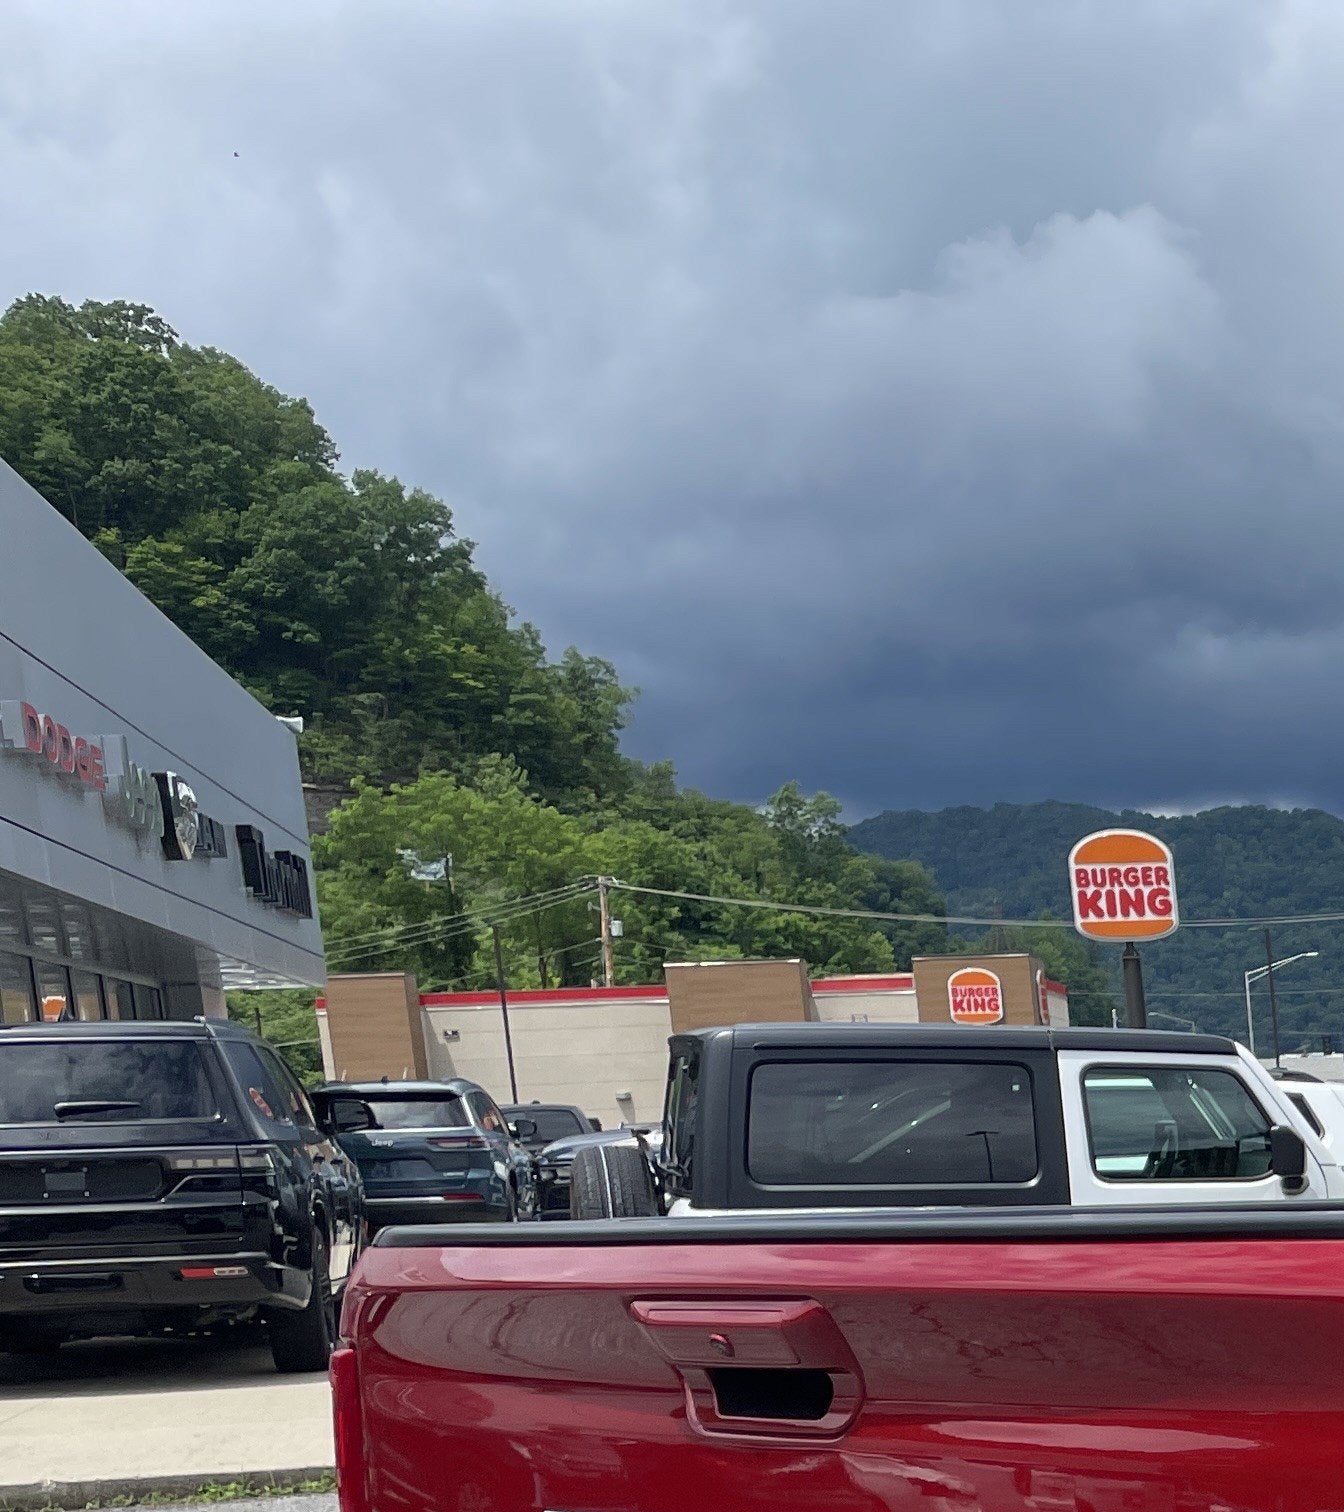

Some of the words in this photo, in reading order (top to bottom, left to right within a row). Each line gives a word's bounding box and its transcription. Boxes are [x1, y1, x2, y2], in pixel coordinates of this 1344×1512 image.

[20, 701, 106, 792] DODGE
[1075, 866, 1170, 888] BURGER
[1077, 887, 1173, 919] KING
[951, 987, 999, 998] BURGER
[952, 998, 1000, 1012] KING
[371, 1139, 394, 1148] Jeep
